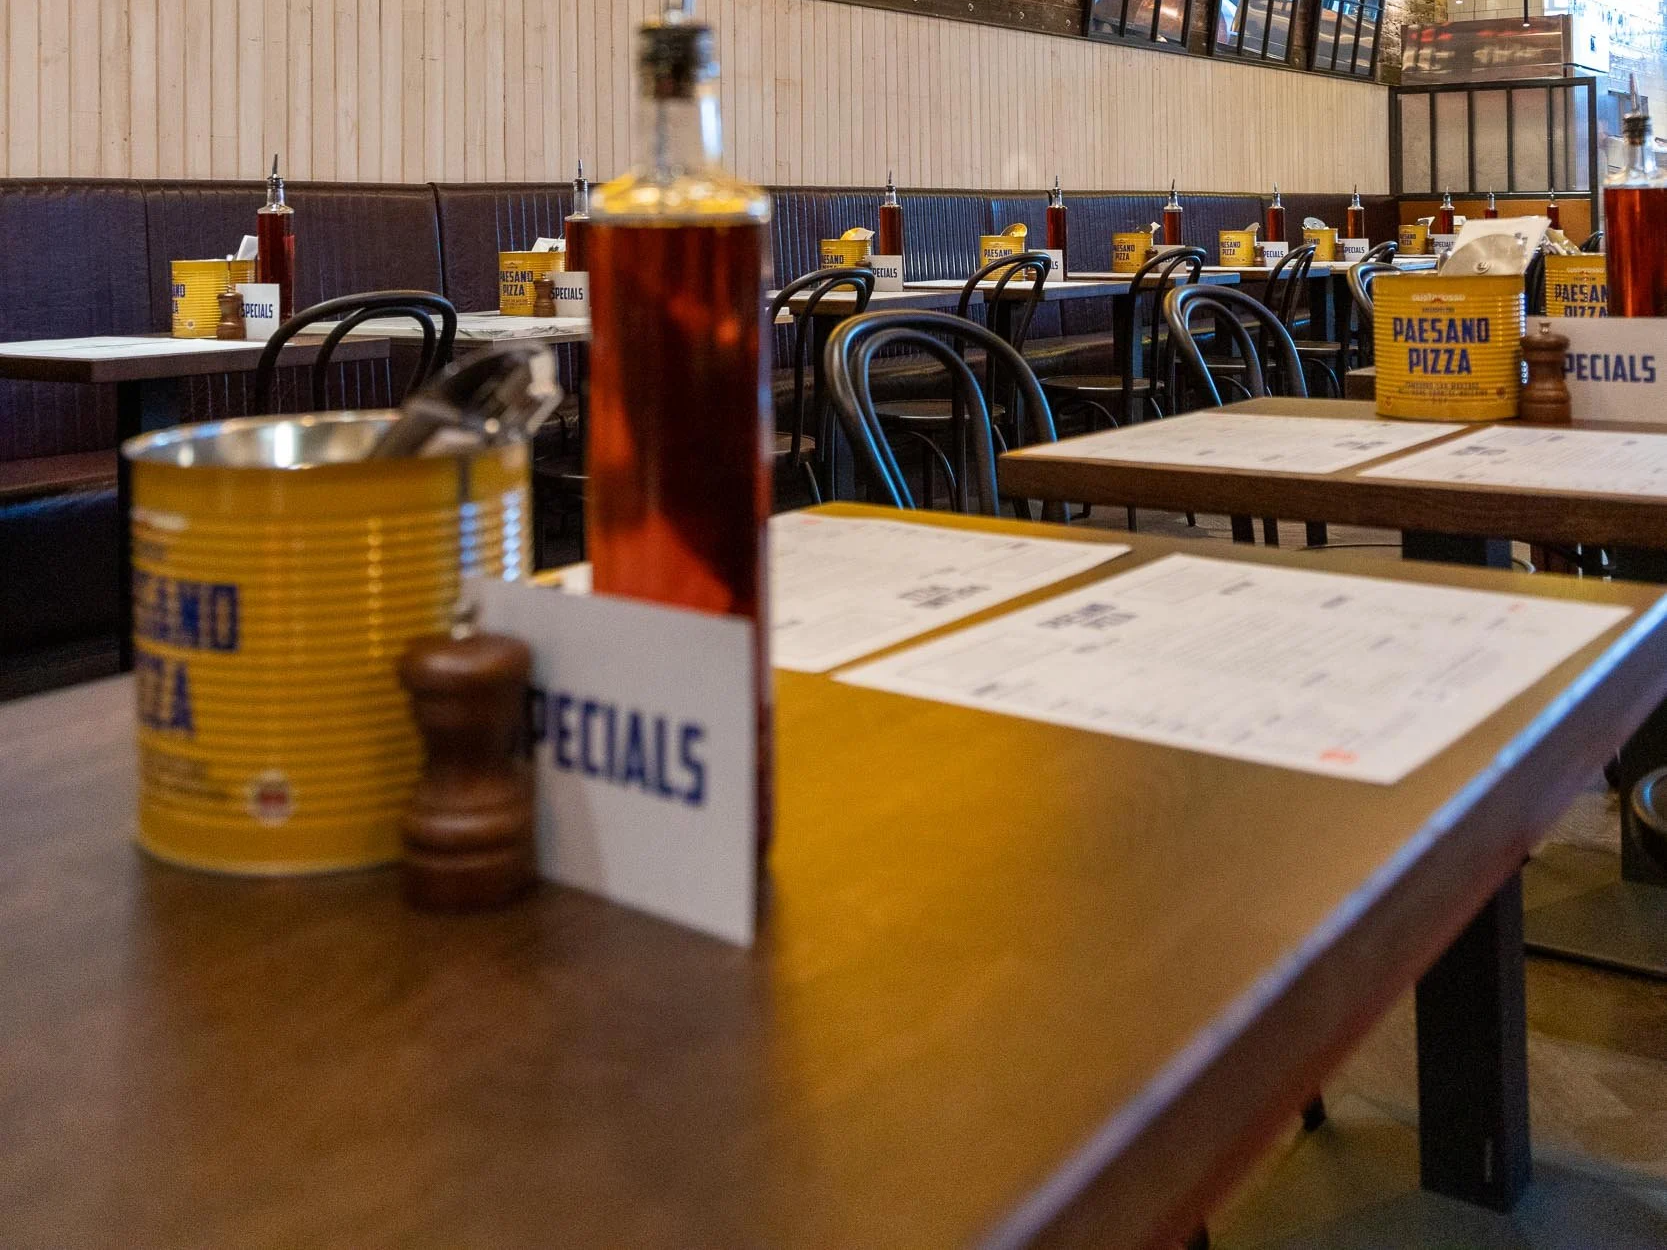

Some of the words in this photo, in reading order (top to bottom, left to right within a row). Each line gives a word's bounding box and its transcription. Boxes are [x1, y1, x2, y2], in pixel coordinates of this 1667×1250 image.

[1263, 250, 1284, 258] PECIALS
[1344, 246, 1365, 254] PECIALS
[871, 267, 898, 278] PECIALS
[502, 284, 525, 296] PIZZA
[1554, 283, 1608, 303] PAESAN
[1392, 317, 1490, 344] PAESANO
[1408, 347, 1472, 375] PIZZA
[1562, 352, 1656, 384] PECIALS
[533, 688, 706, 808] PECIALS
